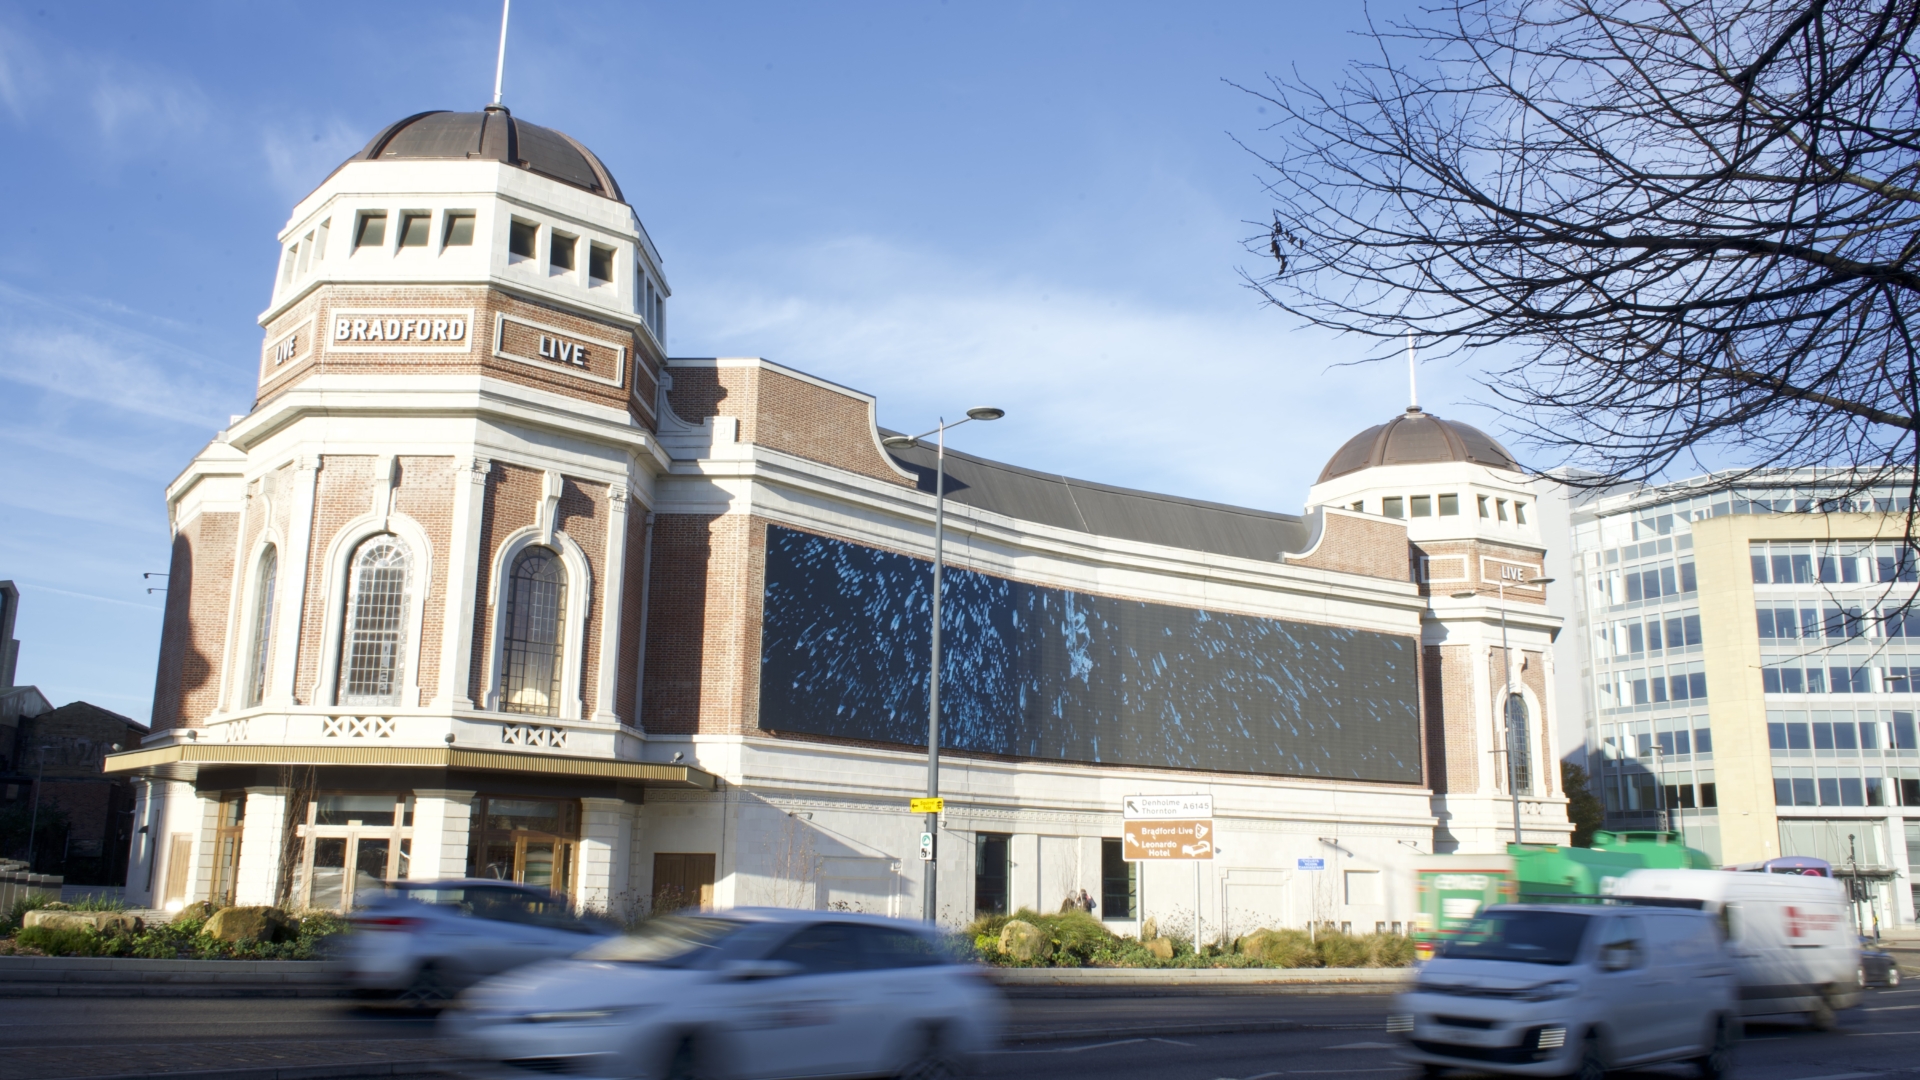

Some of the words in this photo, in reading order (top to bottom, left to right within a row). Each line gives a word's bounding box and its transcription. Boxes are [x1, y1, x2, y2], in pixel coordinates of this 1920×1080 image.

[336, 319, 465, 340] BRADFORD
[275, 335, 296, 365] LIVE
[538, 335, 585, 365] LIVE
[1501, 565, 1524, 581] LIVE
